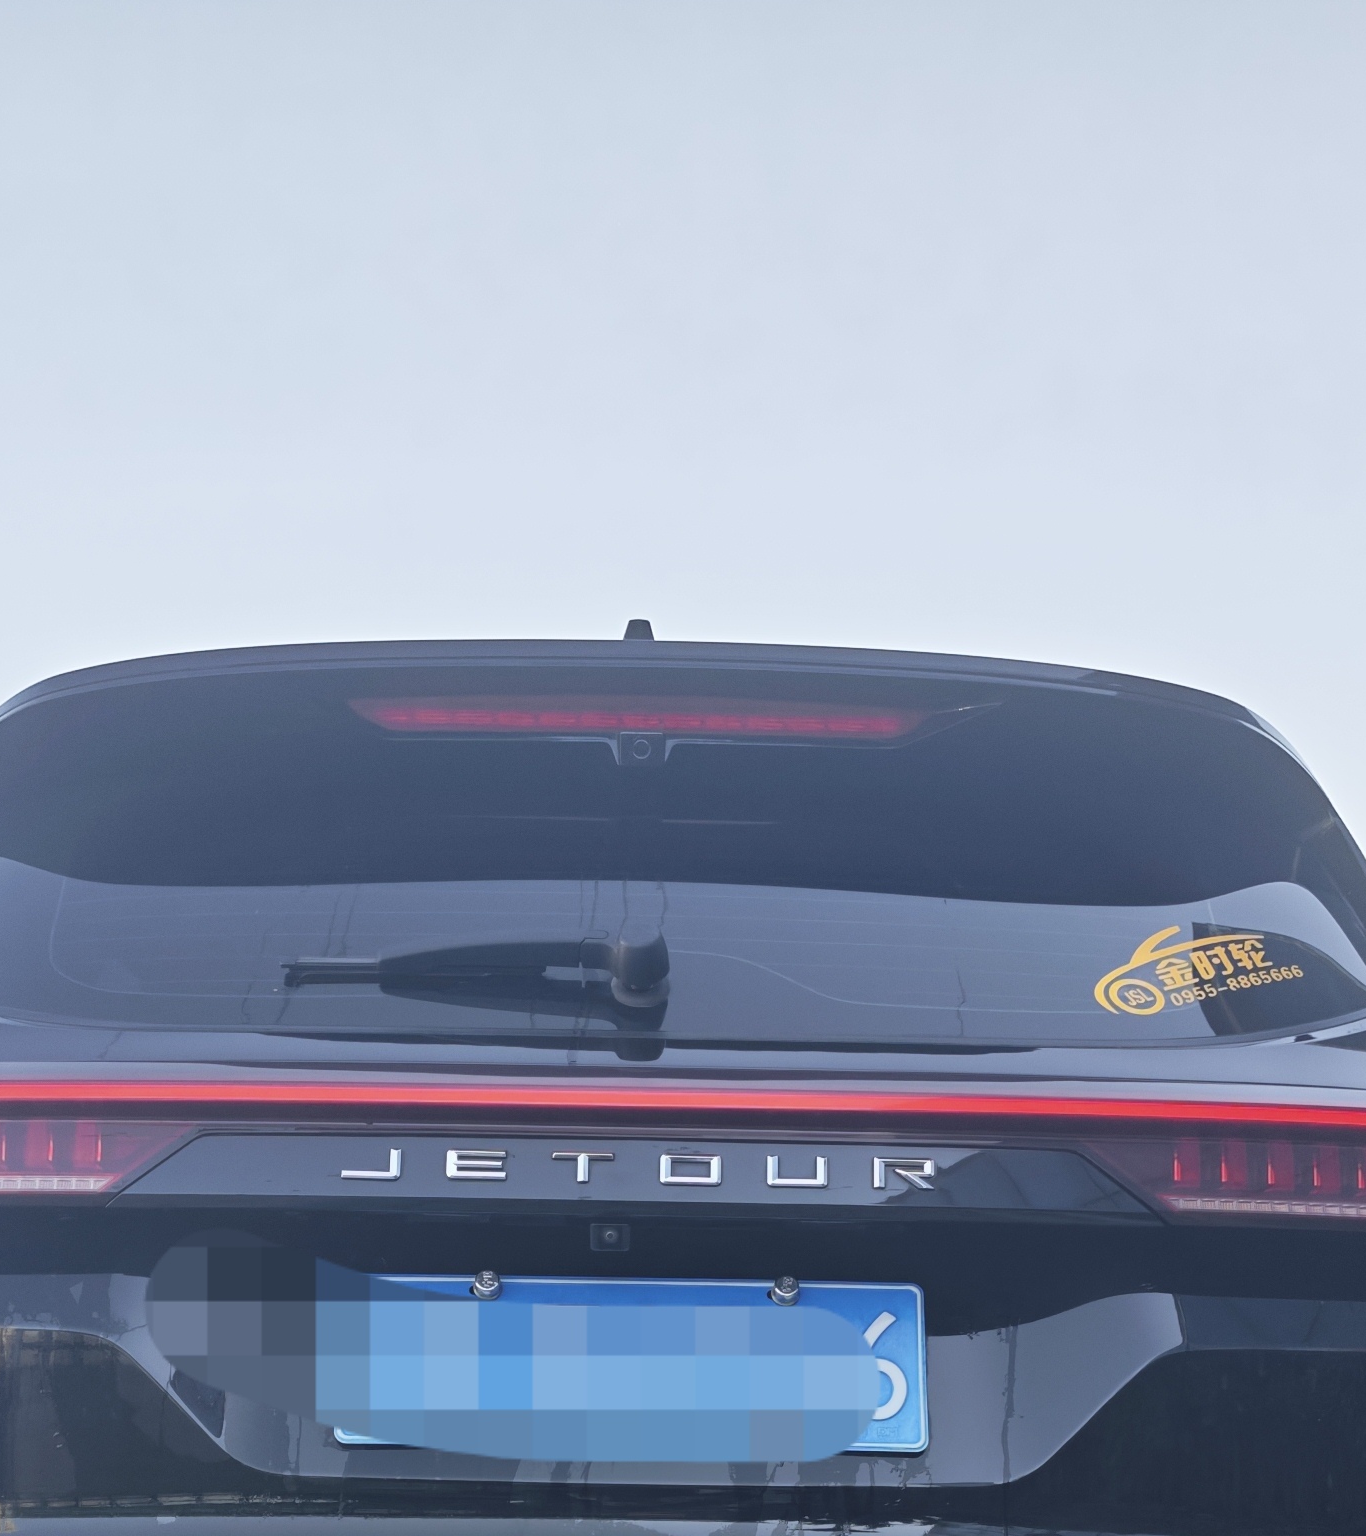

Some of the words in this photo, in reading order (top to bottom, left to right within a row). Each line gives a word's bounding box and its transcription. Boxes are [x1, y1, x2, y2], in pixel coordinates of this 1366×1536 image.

[1155, 940, 1273, 991] 金时轮
[1170, 965, 1304, 1006] 0955-8865666
[1124, 988, 1155, 1006] JSL
[341, 1148, 935, 1190] JETOUR
